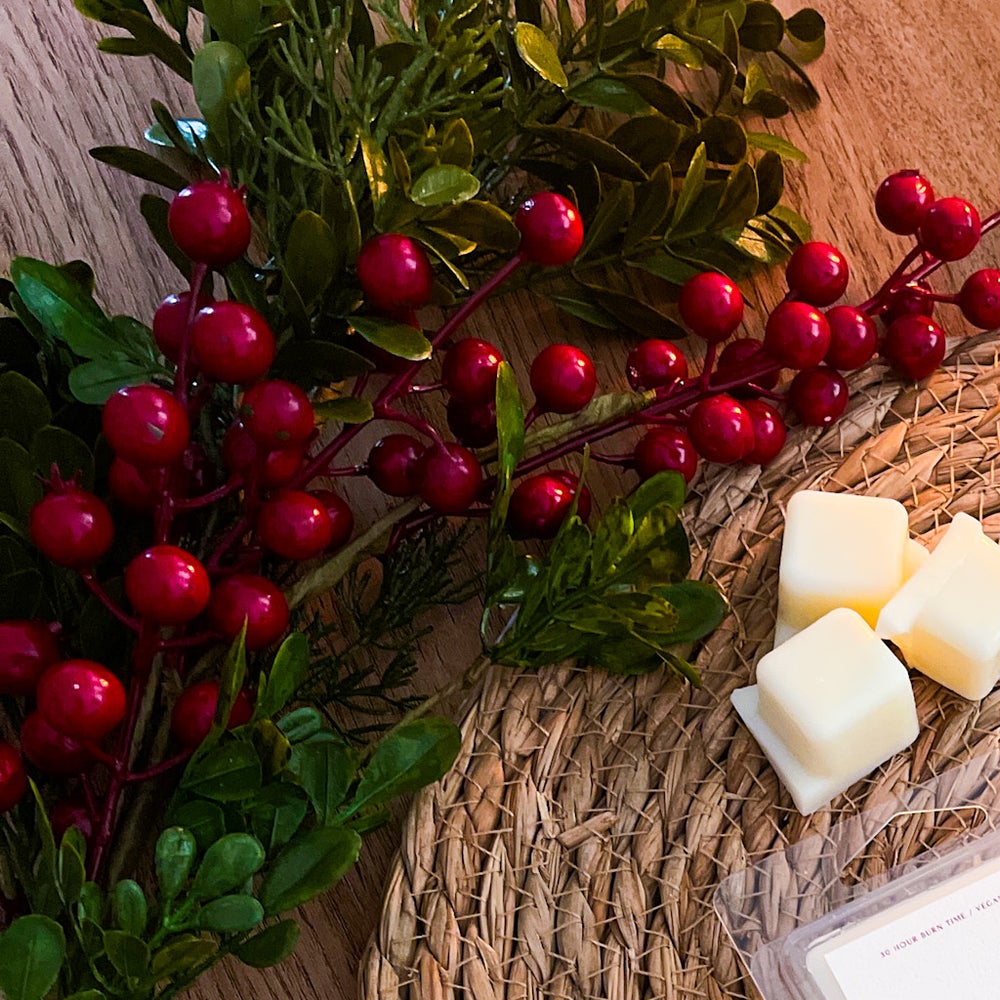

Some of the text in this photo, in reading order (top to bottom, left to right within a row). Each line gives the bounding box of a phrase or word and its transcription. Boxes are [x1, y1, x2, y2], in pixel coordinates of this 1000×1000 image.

[893, 936, 918, 952] HOUR
[920, 924, 943, 939] BURN
[945, 912, 966, 926] TIME
